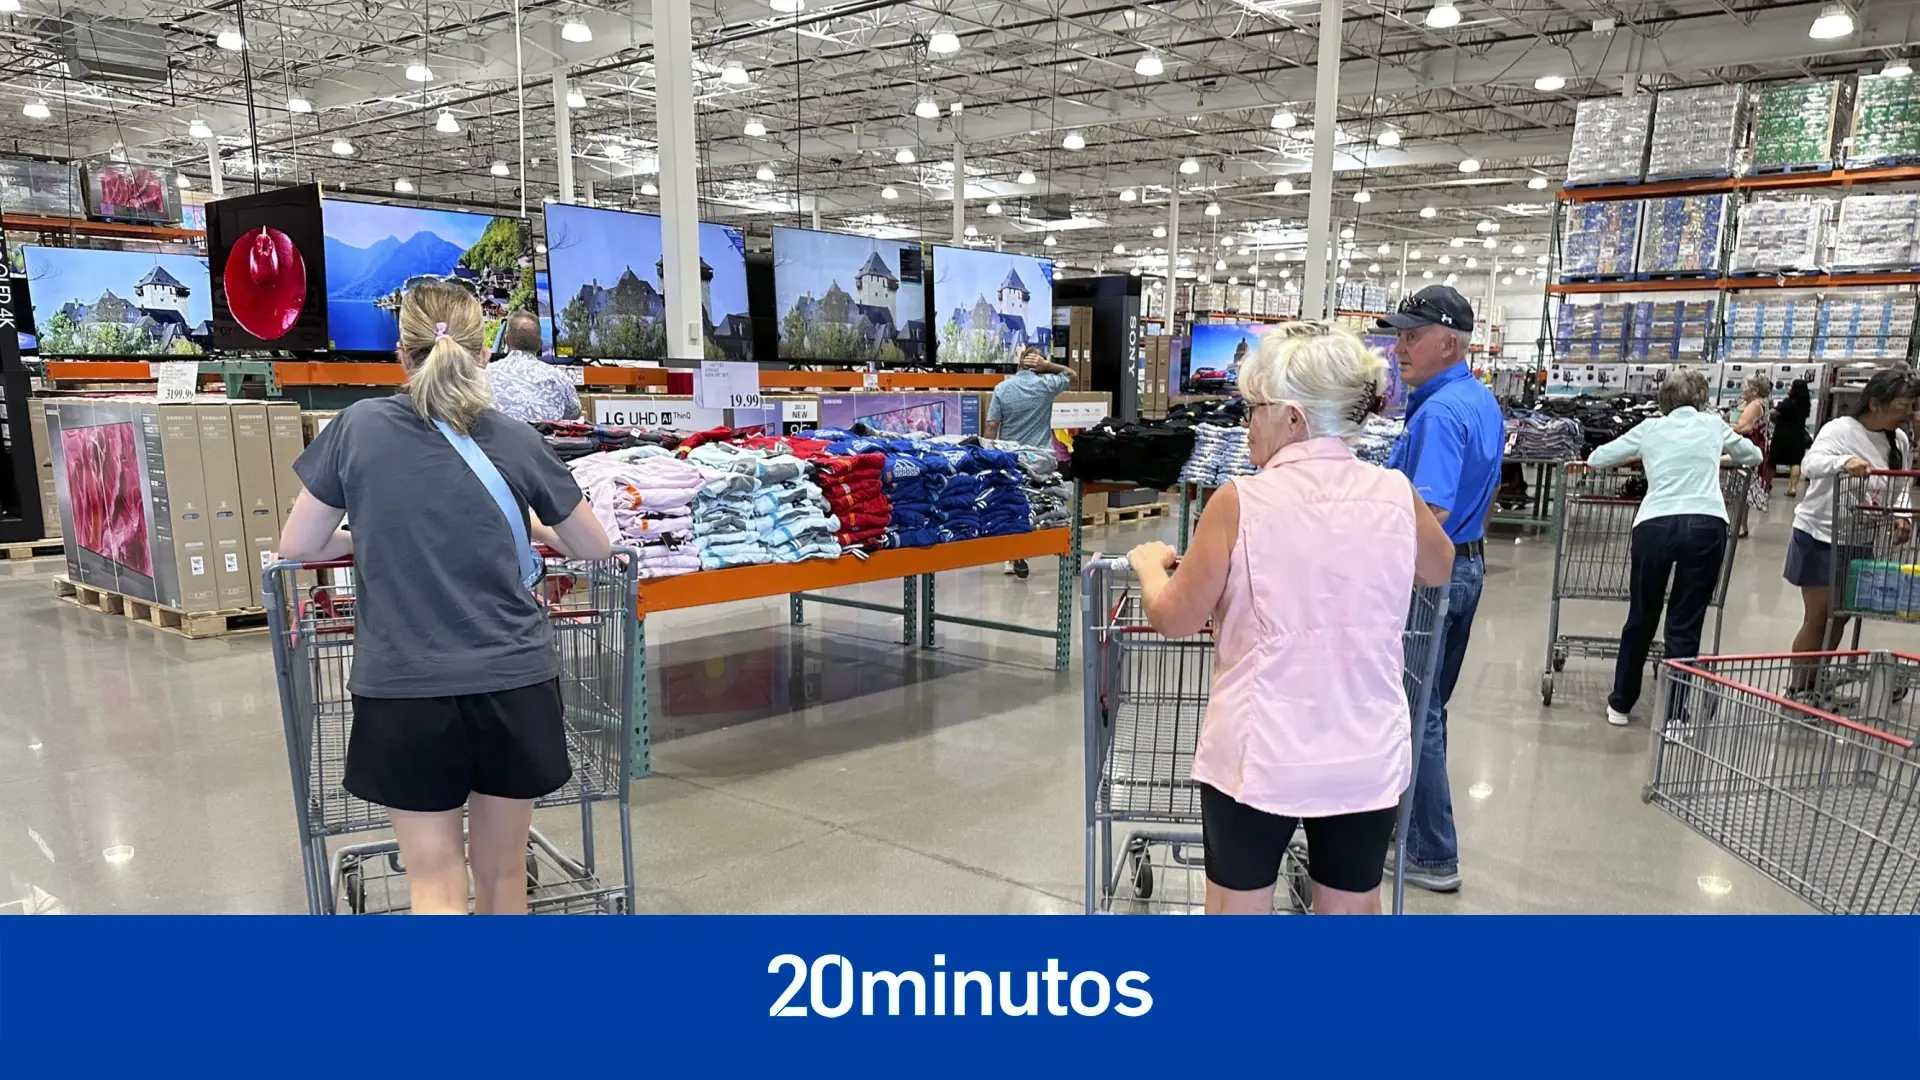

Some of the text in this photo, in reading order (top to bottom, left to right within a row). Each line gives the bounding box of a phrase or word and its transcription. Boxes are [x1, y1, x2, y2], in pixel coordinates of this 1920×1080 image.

[1128, 316, 1137, 377] SONY
[165, 389, 193, 399] 3199.99
[730, 394, 759, 407] 19.99
[605, 412, 624, 425] LG
[630, 412, 658, 425] UHD
[661, 412, 672, 425] AI
[792, 411, 808, 419] NEW
[893, 467, 920, 477] adidas
